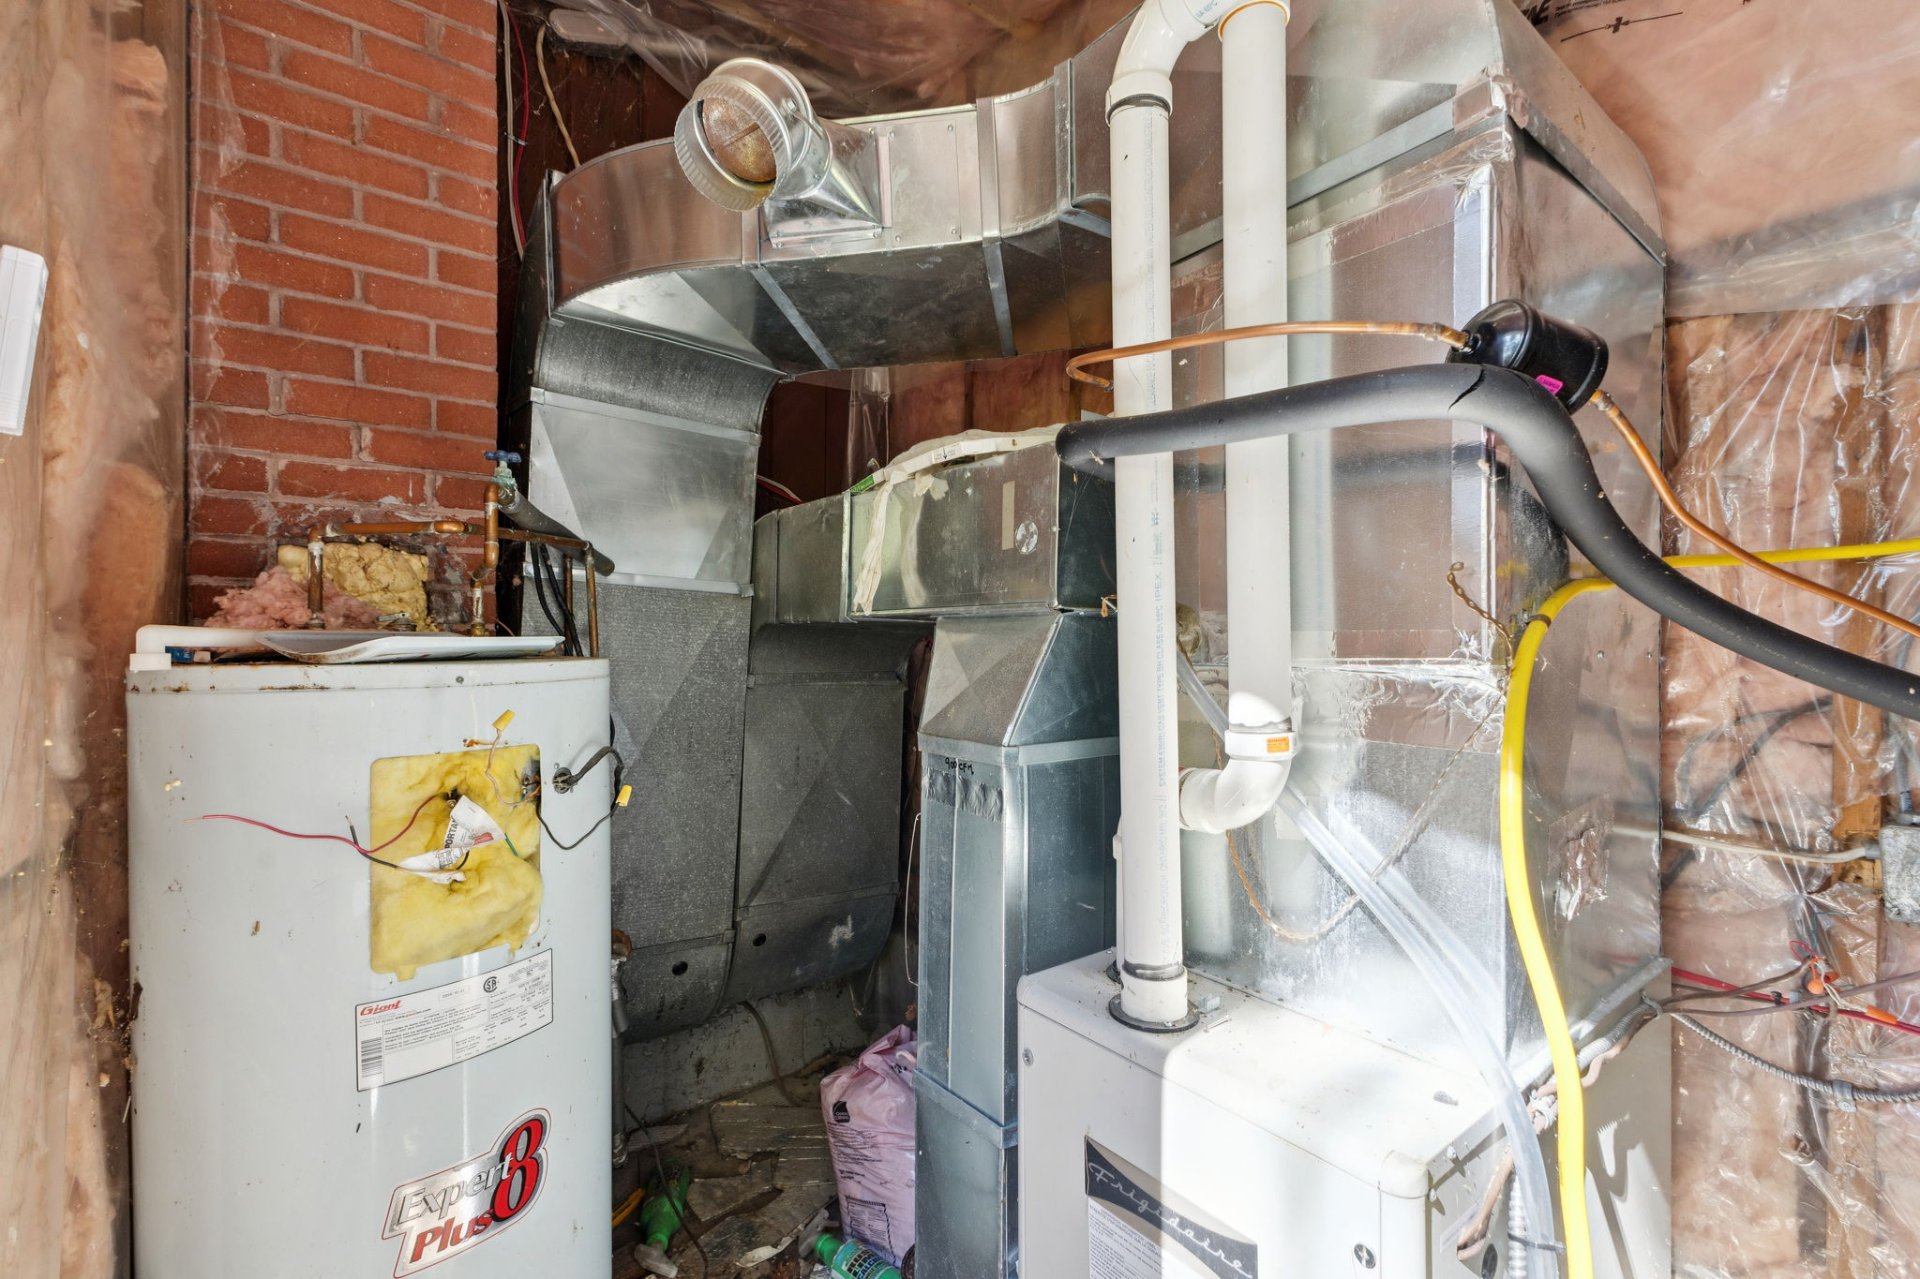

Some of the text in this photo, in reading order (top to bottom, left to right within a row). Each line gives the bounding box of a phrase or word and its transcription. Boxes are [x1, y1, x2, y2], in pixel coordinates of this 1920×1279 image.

[360, 1000, 402, 1016] Giant
[398, 1118, 544, 1225] Expert 8
[409, 1209, 494, 1264] Plus
[1088, 1162, 1253, 1279] Frigidaire
